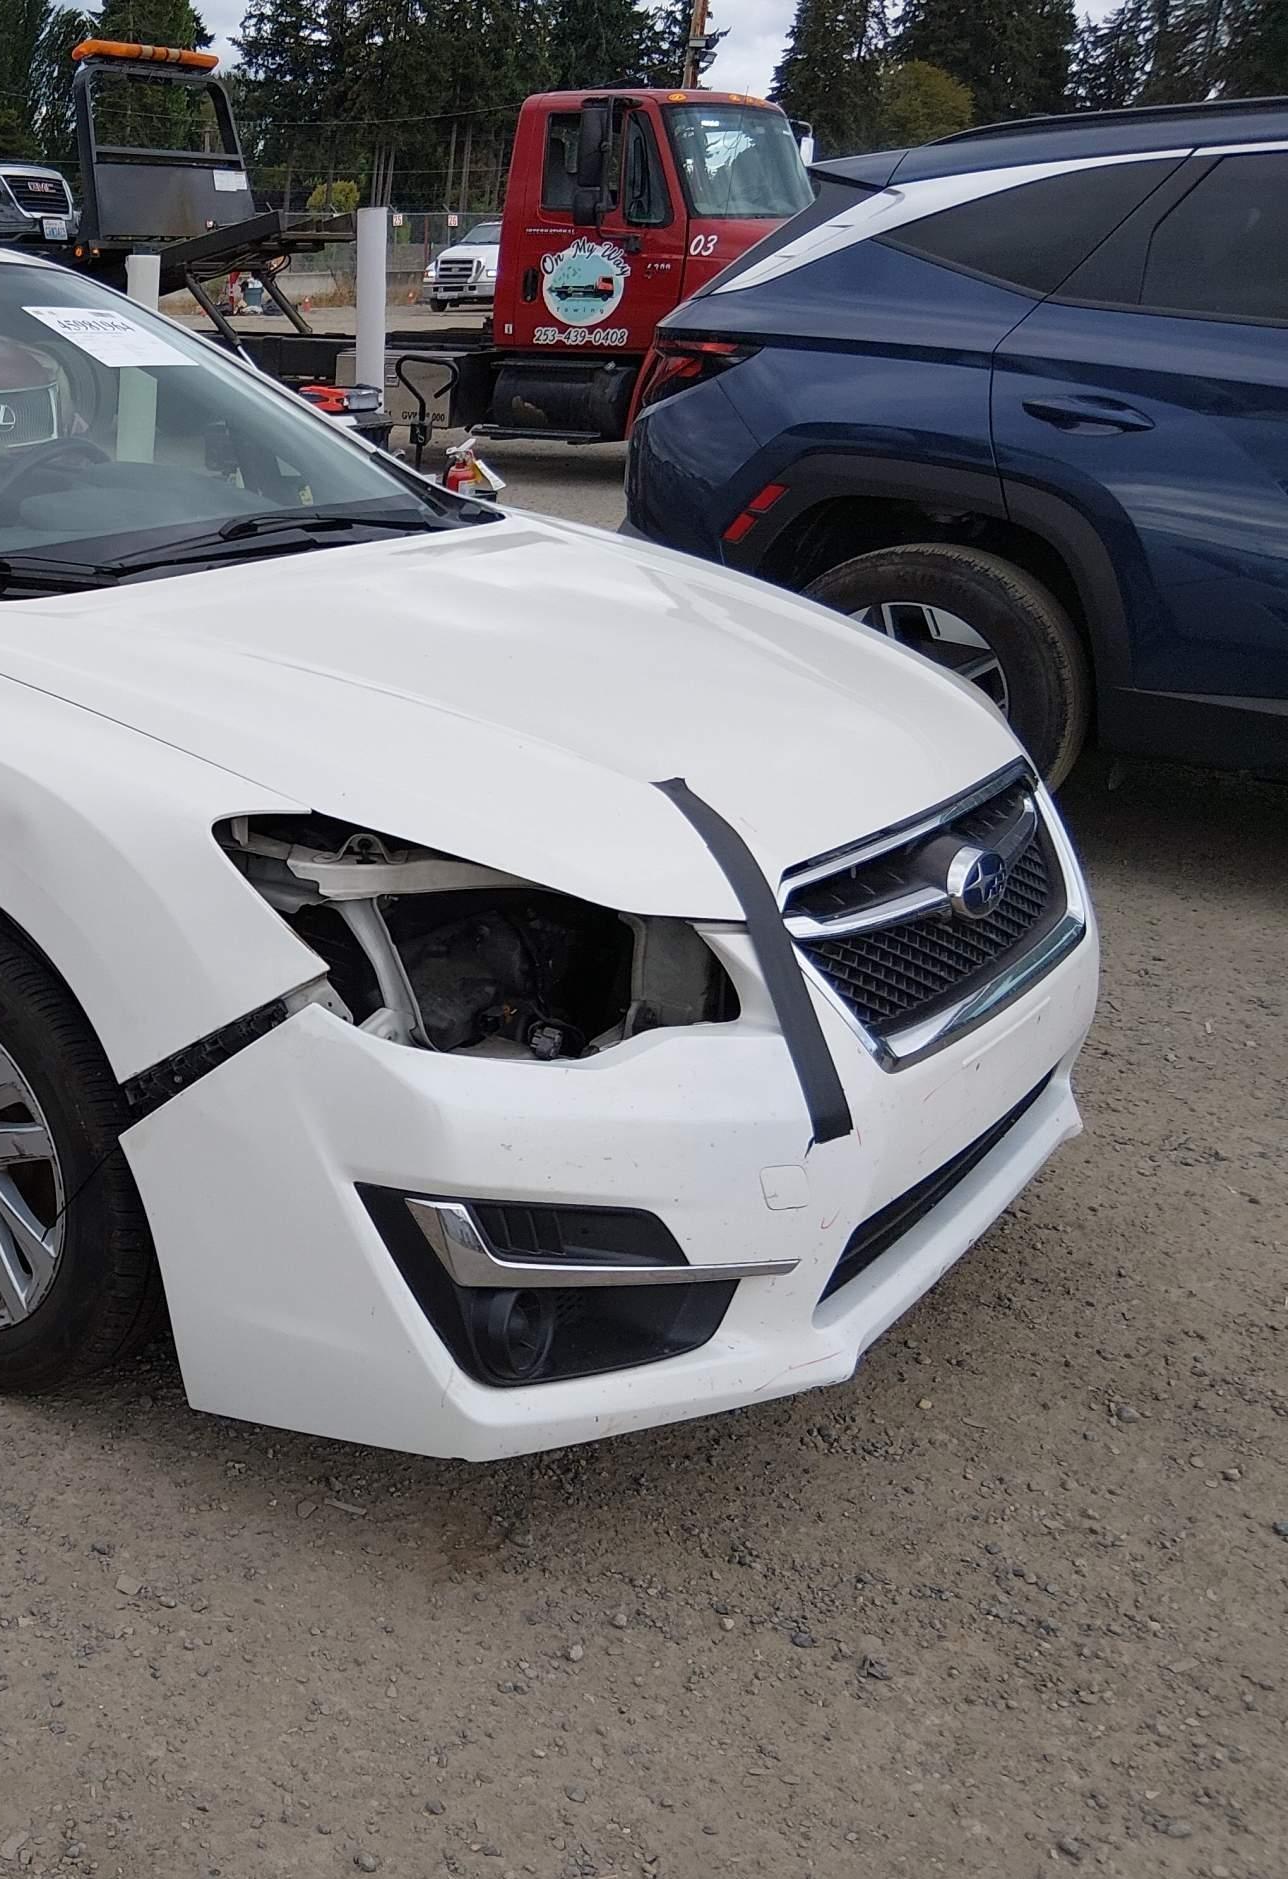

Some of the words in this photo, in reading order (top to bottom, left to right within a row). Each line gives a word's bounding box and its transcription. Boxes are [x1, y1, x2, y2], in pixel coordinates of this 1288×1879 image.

[27, 181, 57, 193] GMC
[394, 214, 402, 226] 25
[448, 215, 457, 226] 26
[689, 234, 718, 256] 03
[541, 254, 565, 275] On
[571, 238, 596, 260] My
[600, 242, 630, 277] Way
[56, 319, 137, 333] 45981964
[534, 327, 628, 345] 253-439-0408
